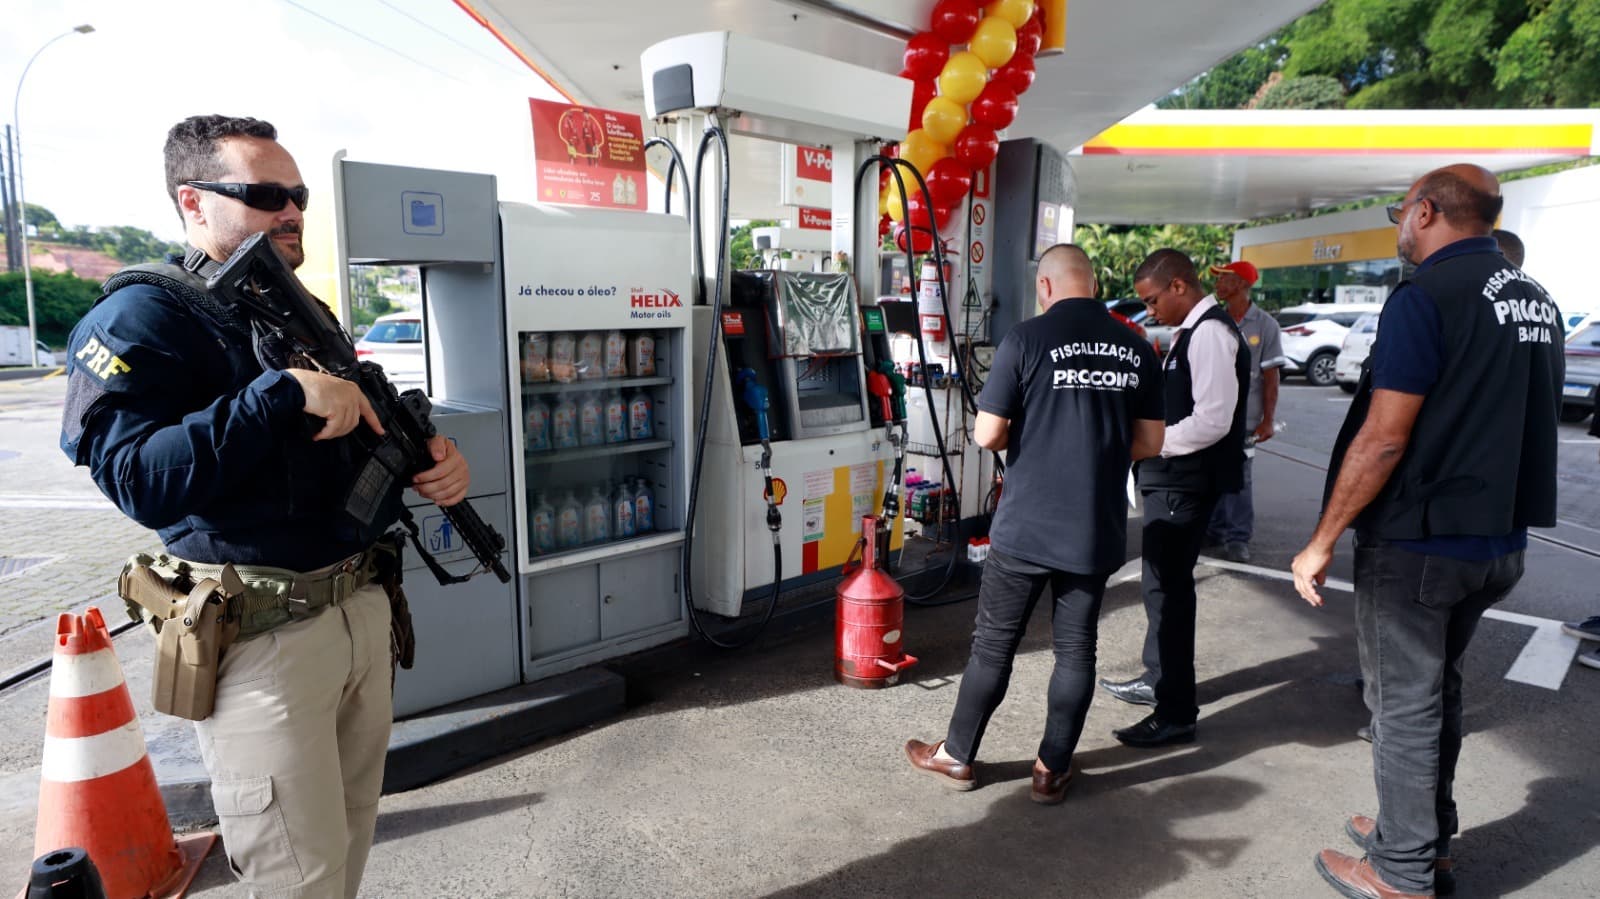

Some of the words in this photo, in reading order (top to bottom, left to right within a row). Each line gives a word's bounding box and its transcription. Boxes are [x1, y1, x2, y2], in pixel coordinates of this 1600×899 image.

[803, 150, 832, 170] V-Po
[518, 284, 532, 296] Já
[535, 285, 574, 296] checou
[577, 288, 584, 296] o
[587, 286, 617, 297] óleo?
[630, 295, 681, 308] HELIX
[630, 311, 655, 319] Motor
[657, 310, 672, 319] oils
[75, 337, 132, 380] PRF
[1049, 342, 1141, 368] FISCALIZAÇÃO
